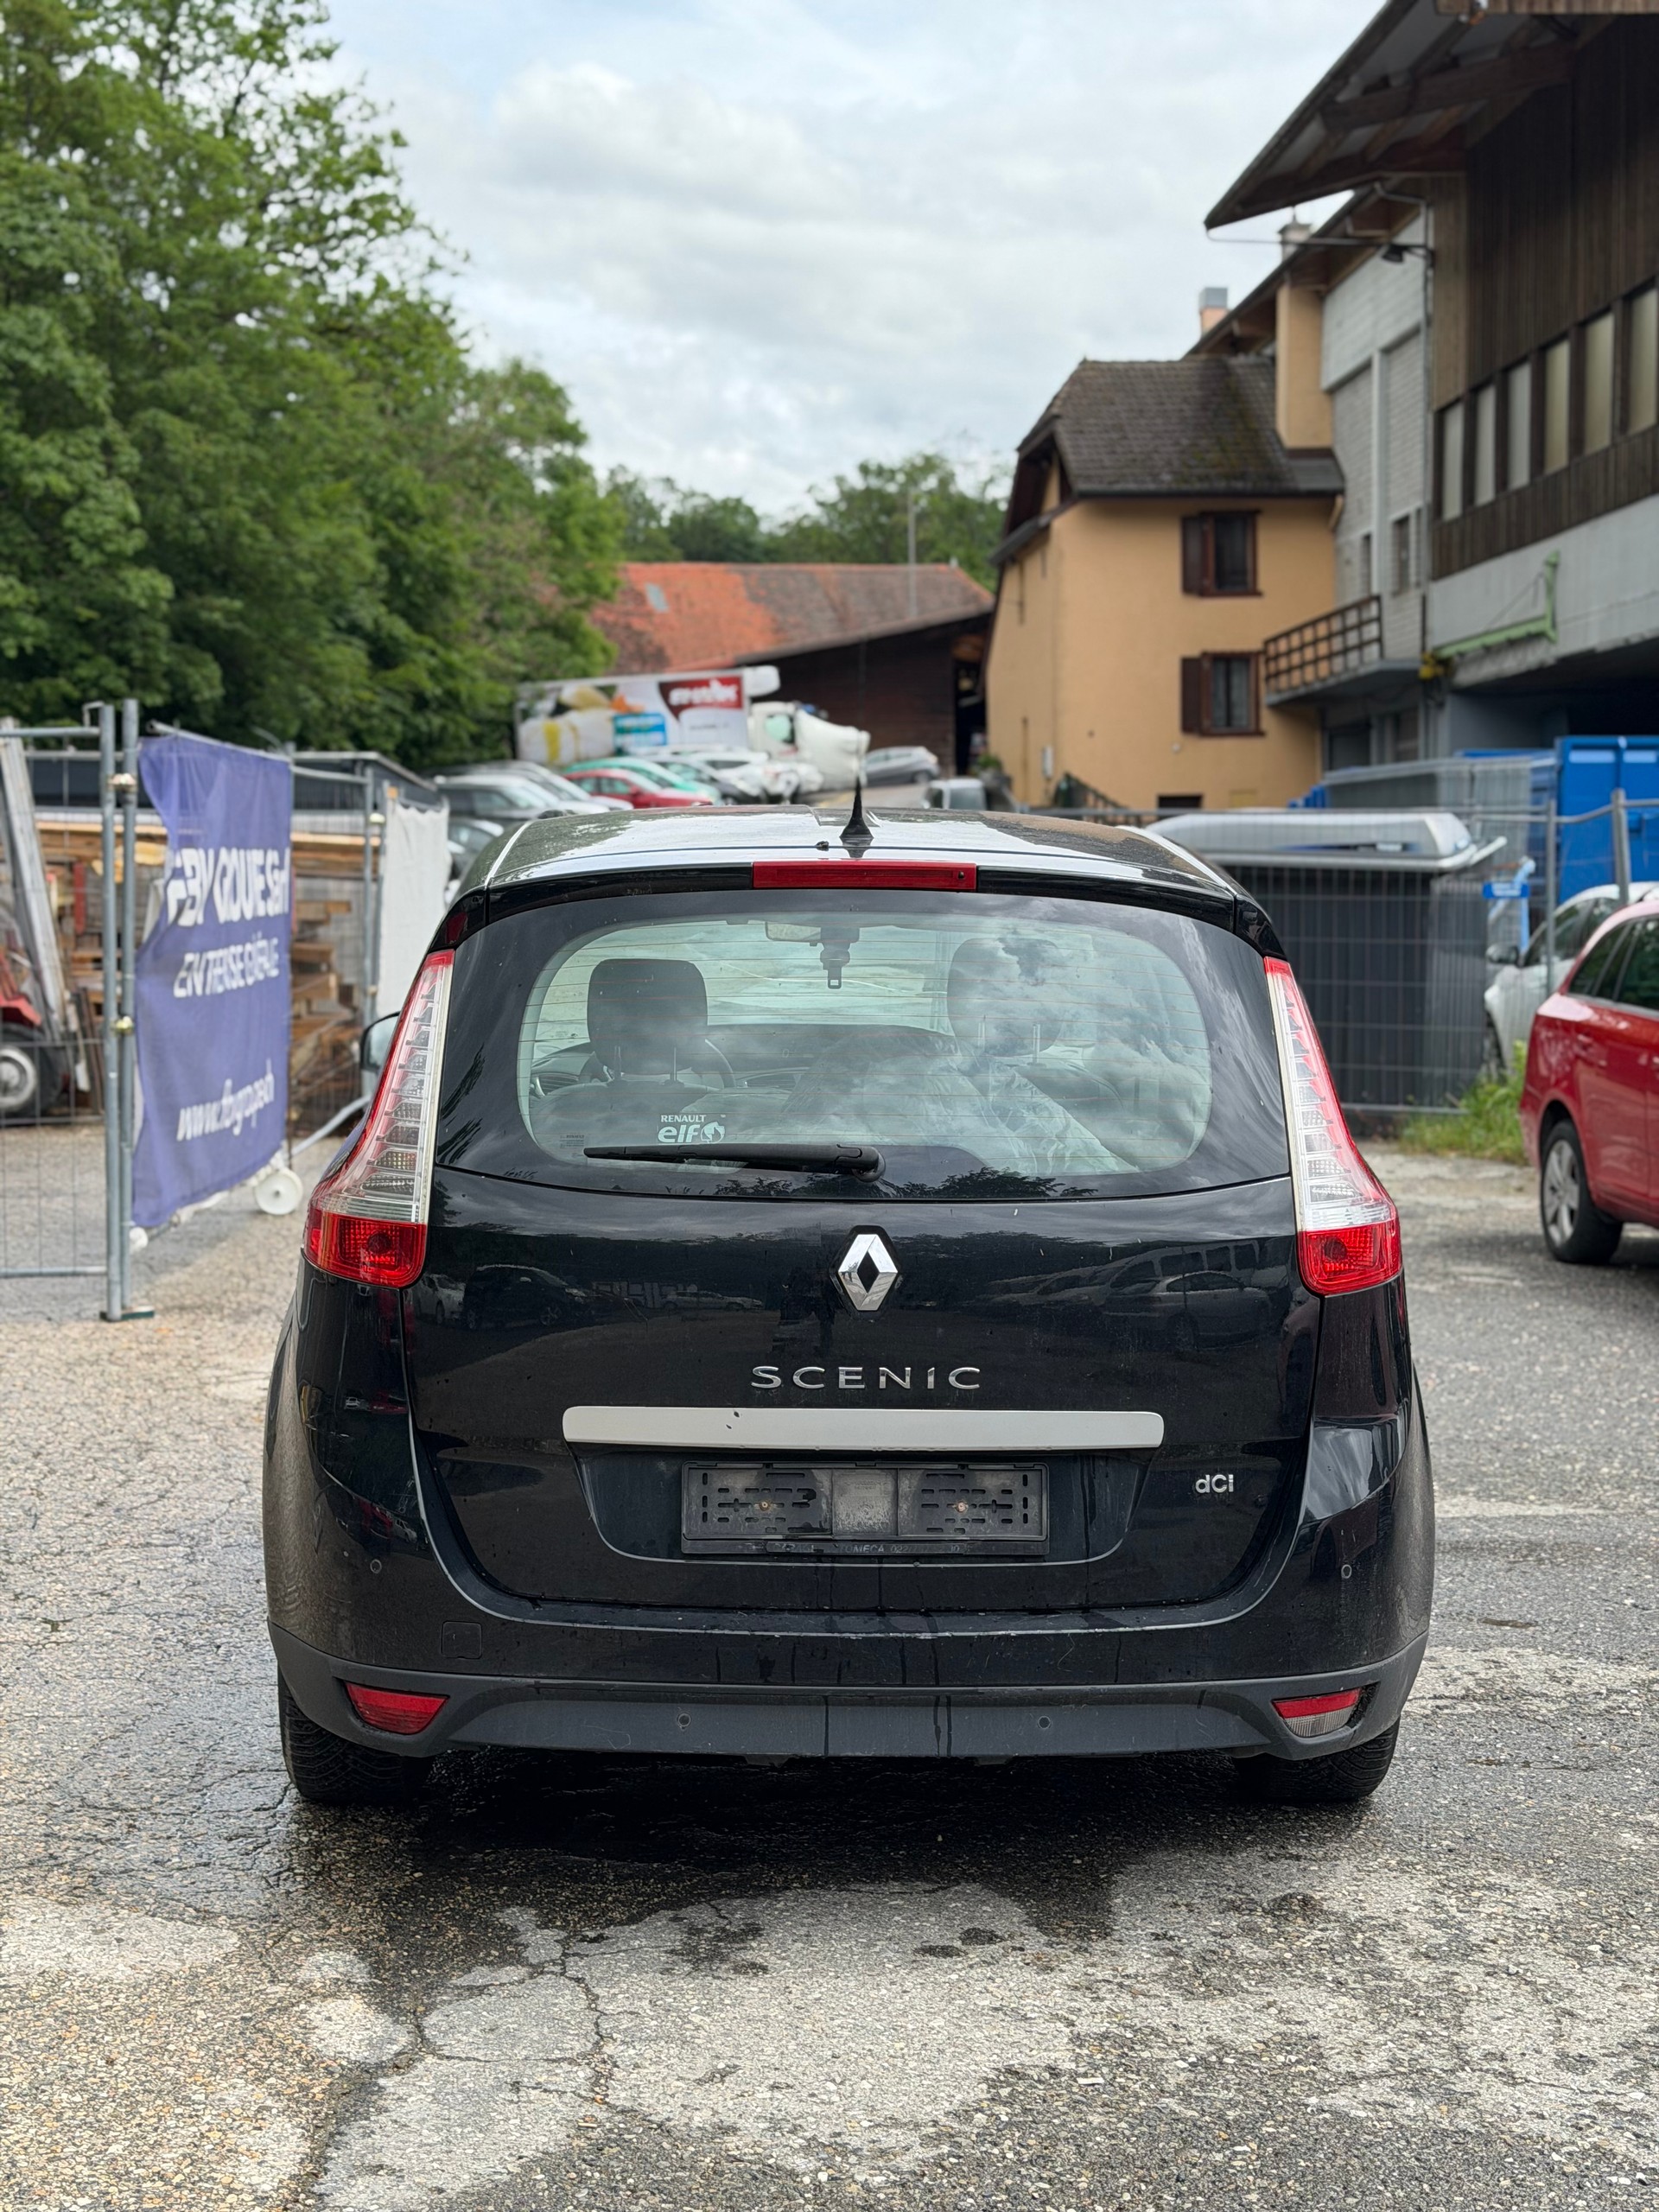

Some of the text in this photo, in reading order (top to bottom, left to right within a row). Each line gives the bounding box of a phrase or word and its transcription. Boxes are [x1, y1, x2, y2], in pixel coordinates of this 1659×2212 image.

[658, 1124, 701, 1143] elf
[751, 1365, 981, 1389] SCENIC
[1195, 1474, 1234, 1493] dCi
